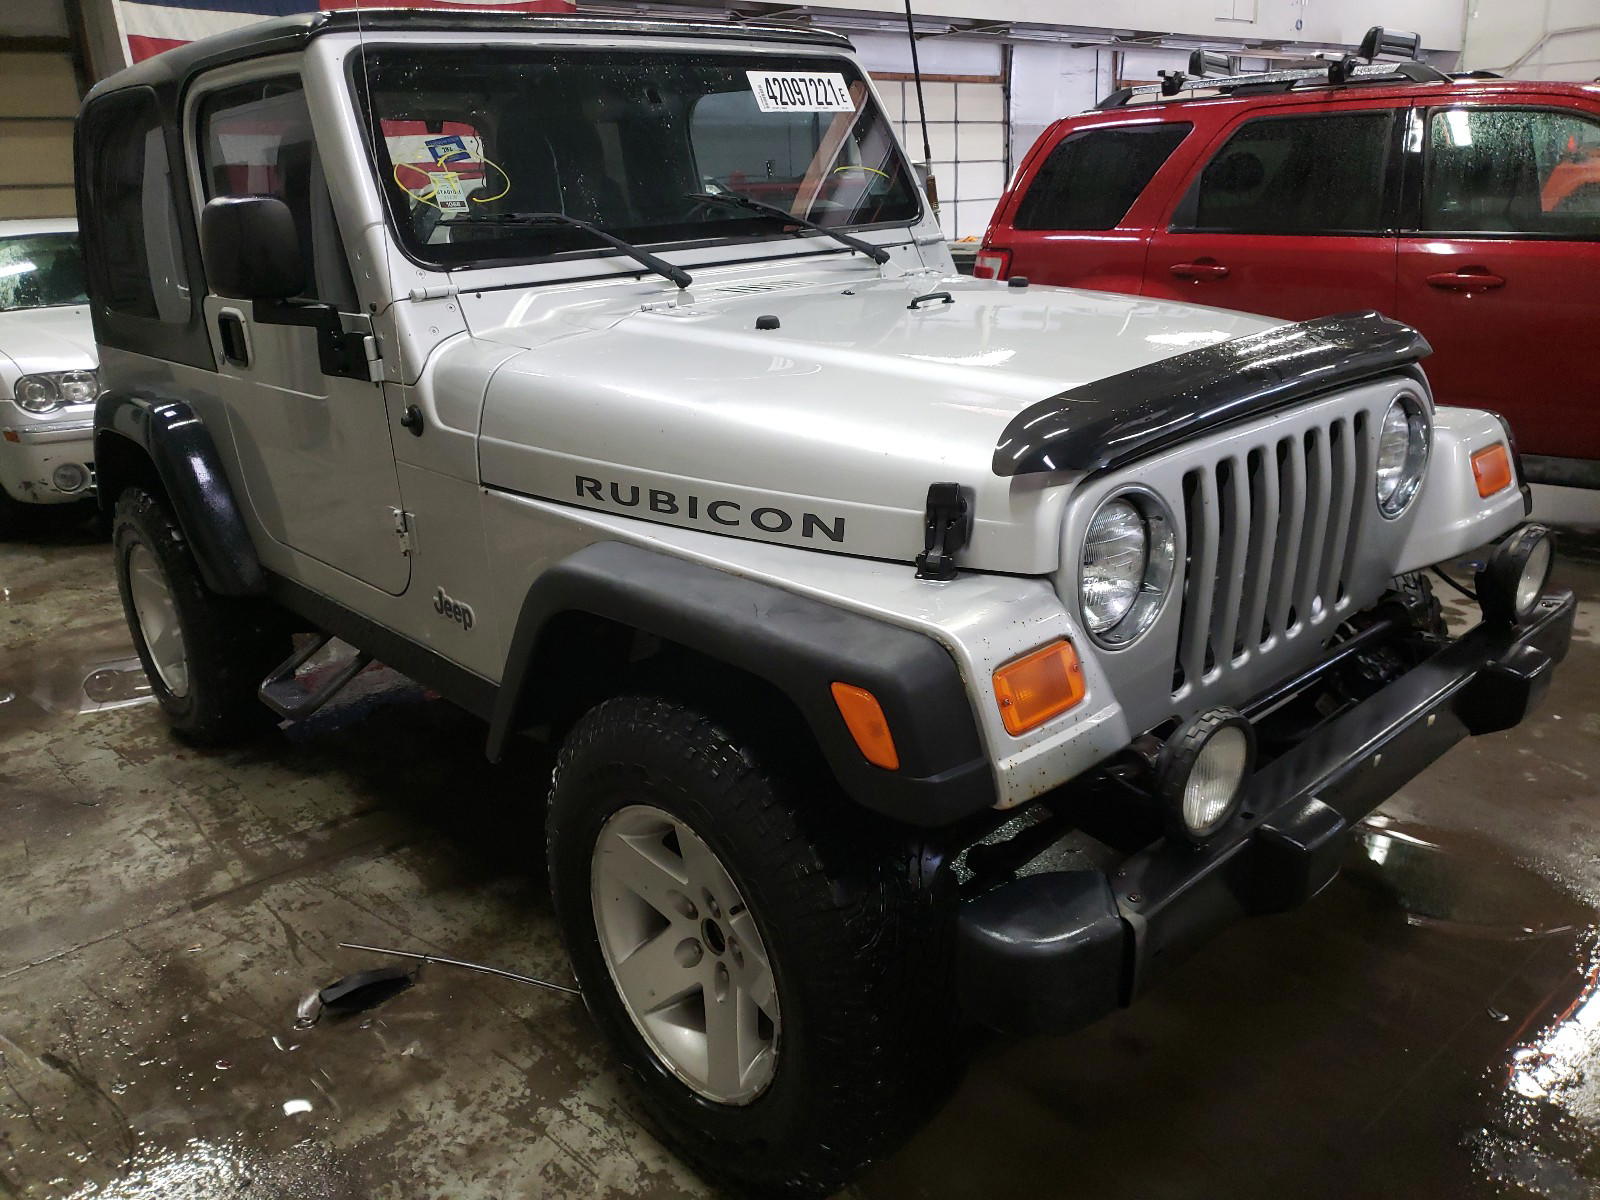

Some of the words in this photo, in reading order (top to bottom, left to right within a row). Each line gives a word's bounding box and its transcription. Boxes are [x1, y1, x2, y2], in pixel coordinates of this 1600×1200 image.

[764, 77, 840, 106] 42097221
[575, 475, 845, 542] RUBICON
[433, 590, 473, 631] Jeep
